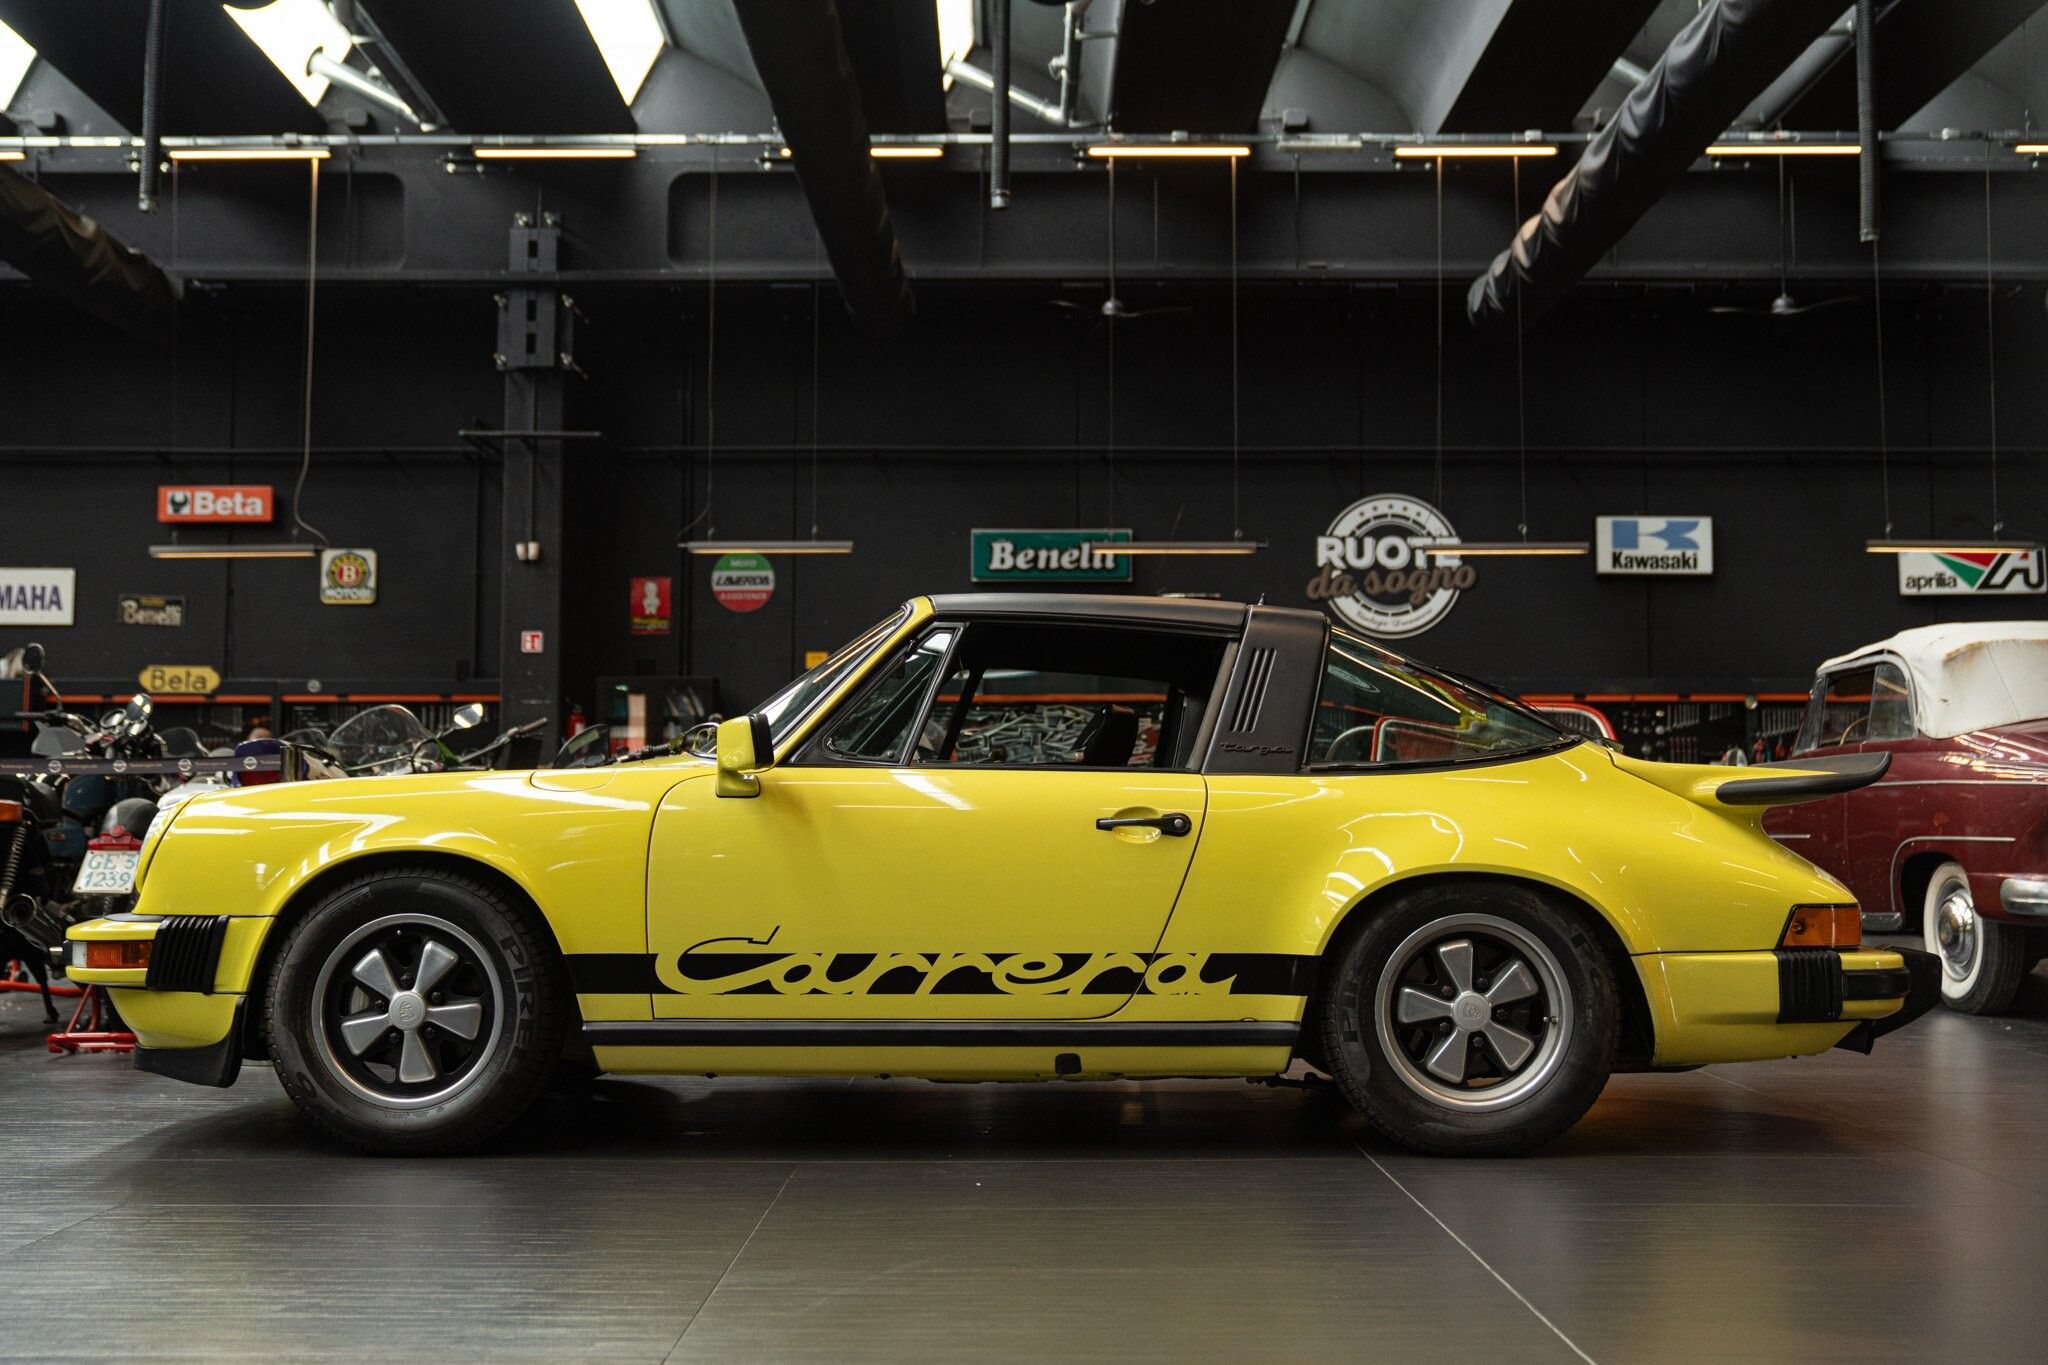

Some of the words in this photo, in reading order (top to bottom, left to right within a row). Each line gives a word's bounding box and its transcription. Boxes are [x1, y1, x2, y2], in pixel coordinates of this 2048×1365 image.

[193, 490, 263, 516] Beta
[1317, 535, 1463, 570] RUOTE
[1612, 551, 1698, 569] Kawasaki
[1306, 563, 1357, 600] da
[1364, 564, 1476, 606] sogno
[1905, 571, 1957, 592] aprilia
[88, 854, 118, 869] GE
[84, 872, 131, 888] 1239
[655, 925, 1239, 996] Carrera
